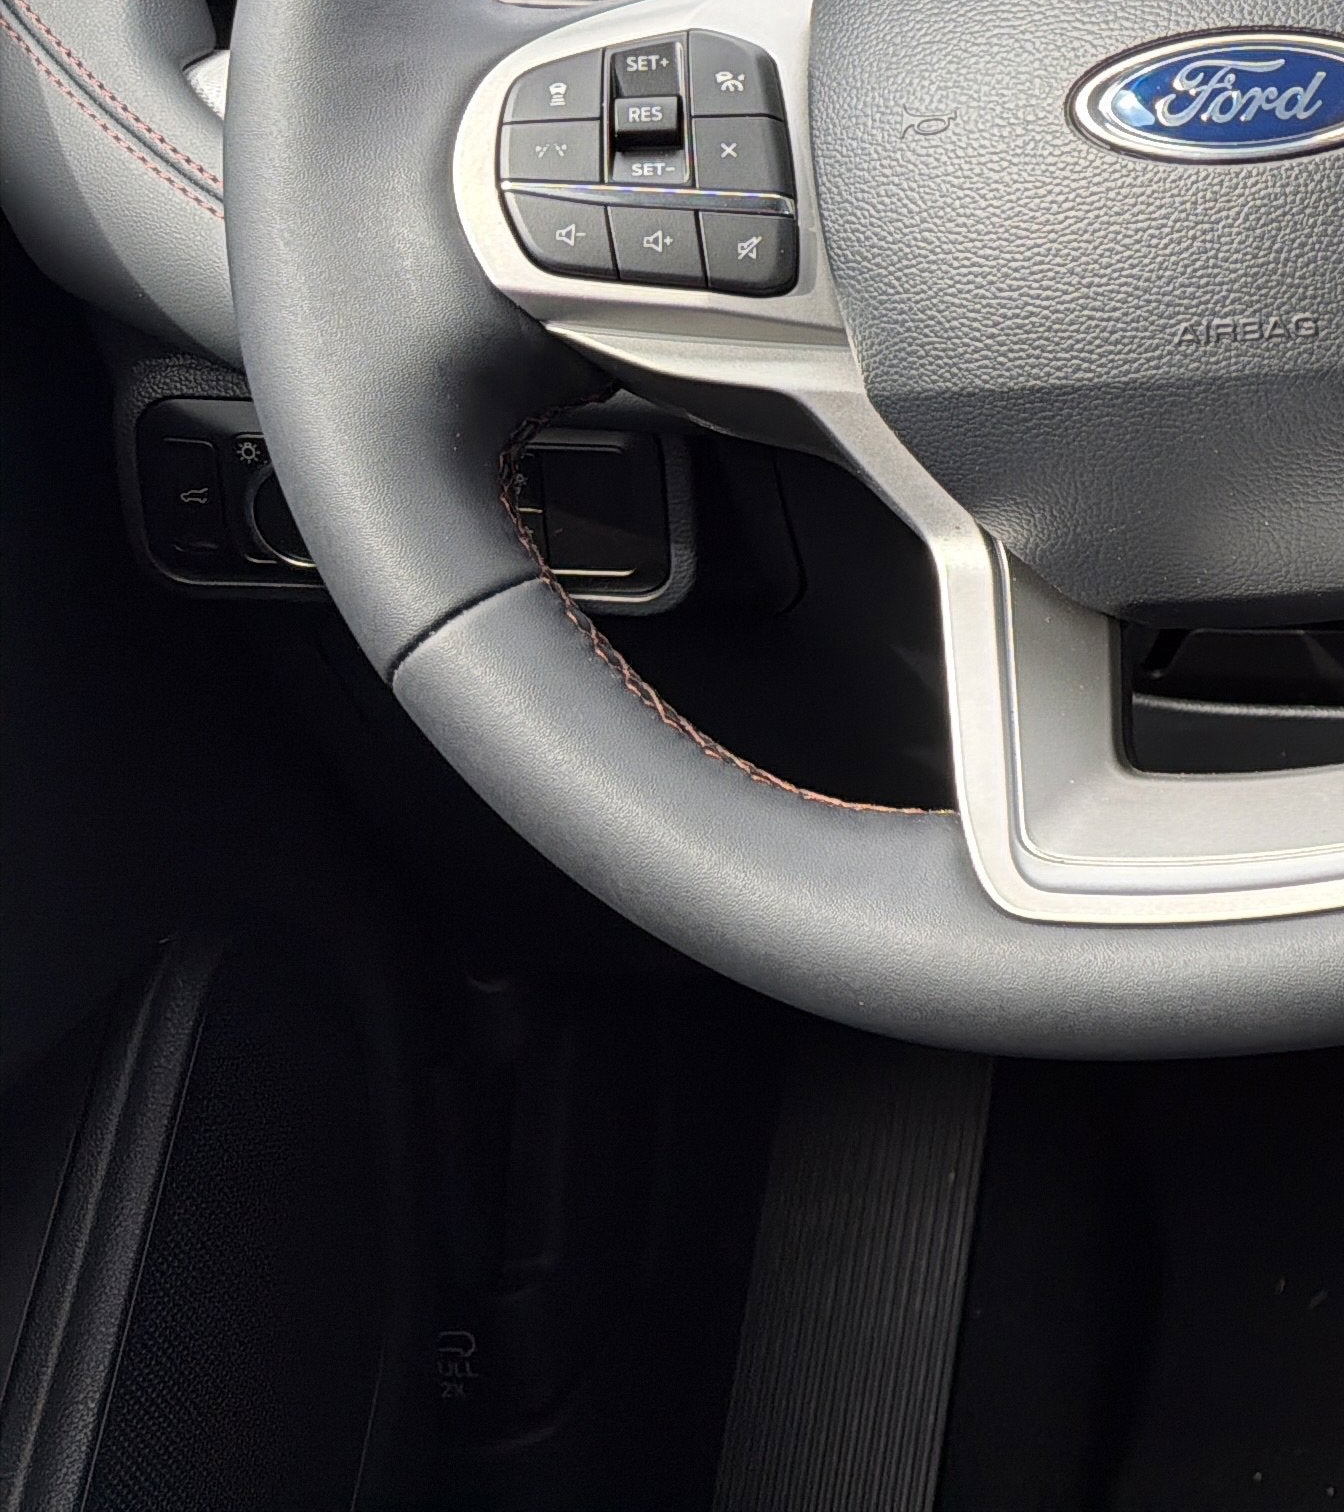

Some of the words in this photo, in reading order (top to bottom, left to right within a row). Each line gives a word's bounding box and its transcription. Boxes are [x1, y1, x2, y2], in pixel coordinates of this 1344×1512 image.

[626, 55, 670, 72] SET+
[1156, 59, 1327, 127] Ford
[628, 106, 663, 123] RES
[631, 163, 675, 177] SET-
[1176, 312, 1320, 345] AIRBAG
